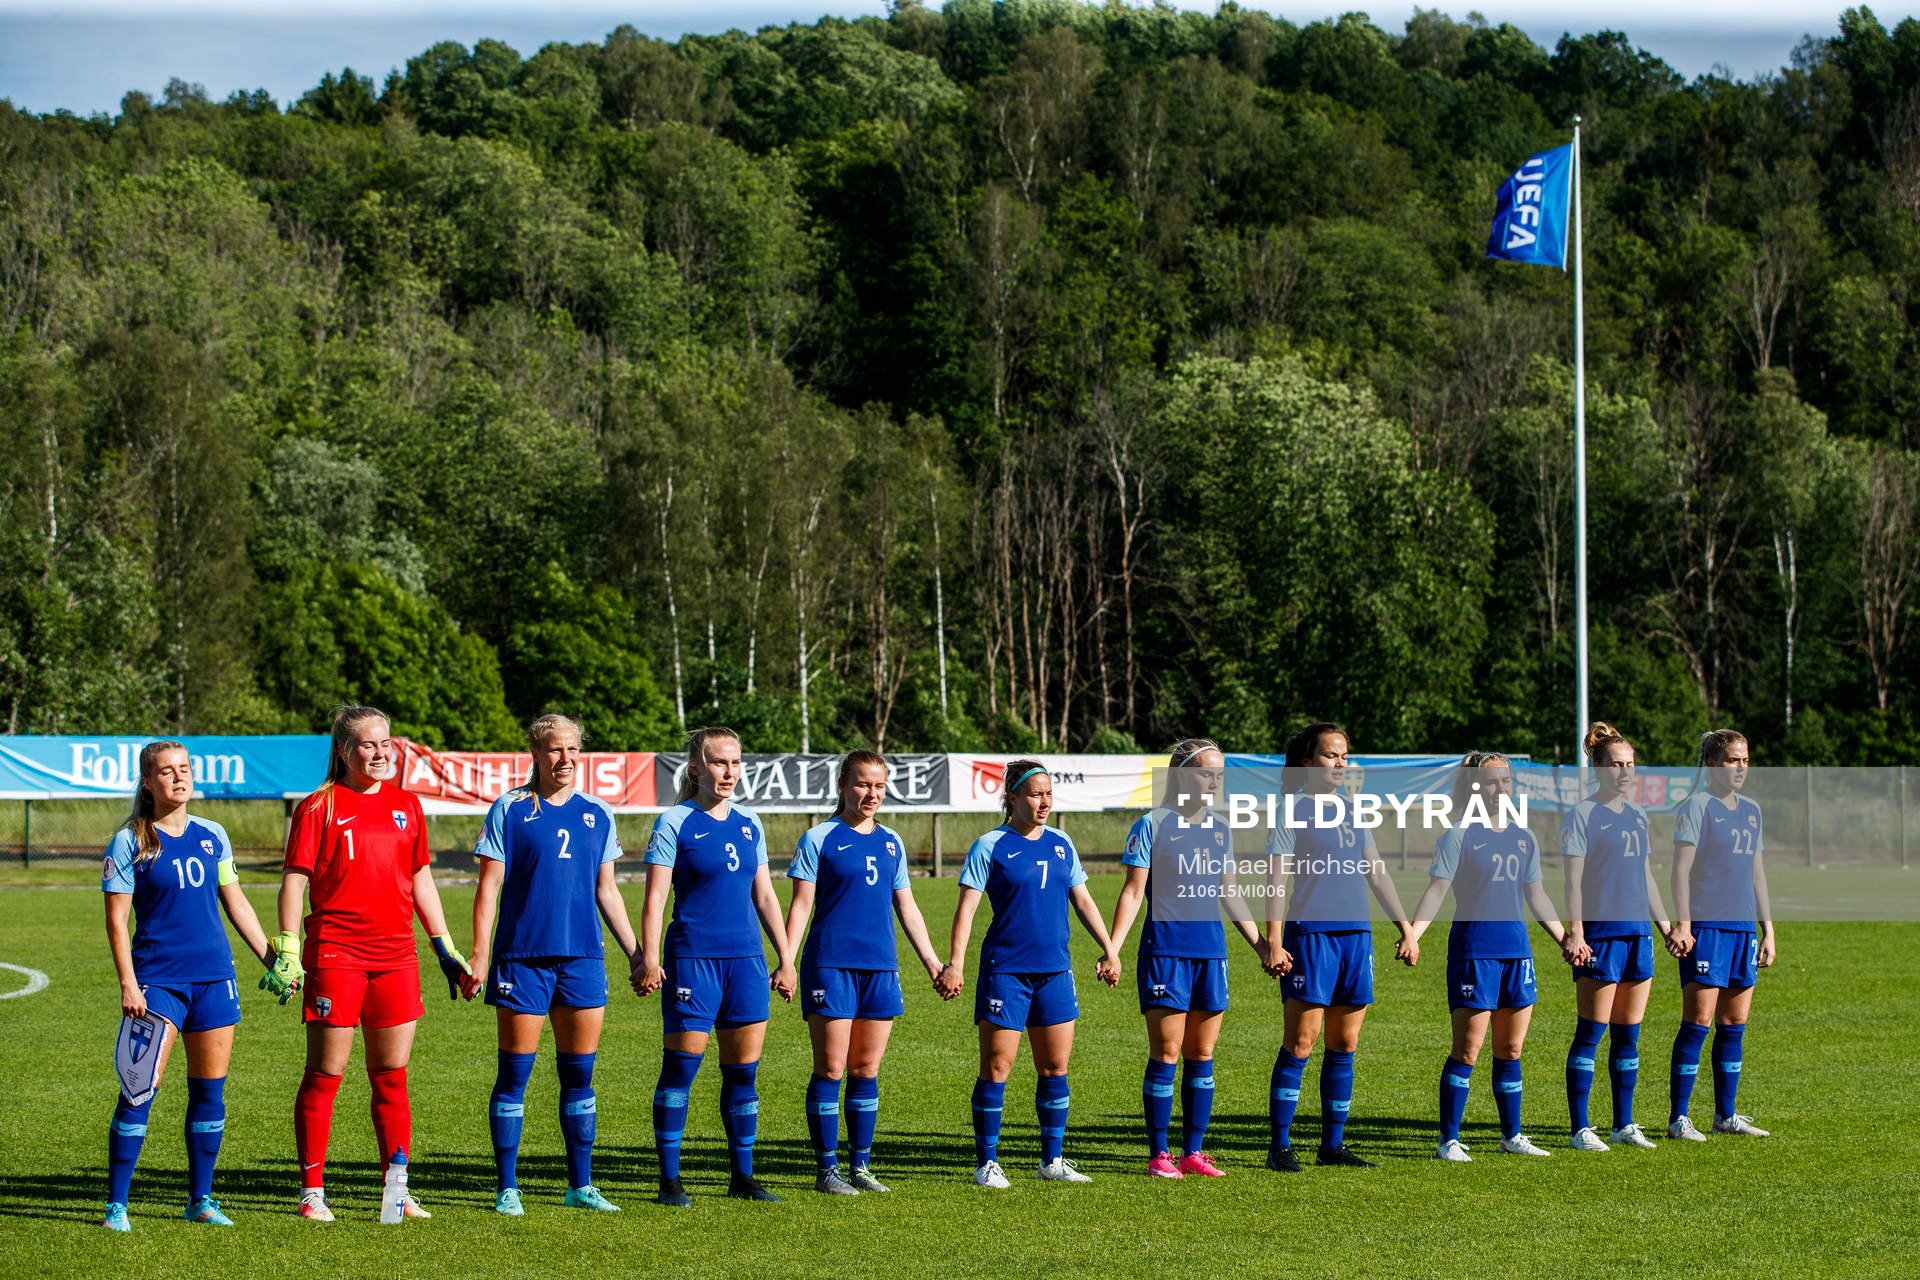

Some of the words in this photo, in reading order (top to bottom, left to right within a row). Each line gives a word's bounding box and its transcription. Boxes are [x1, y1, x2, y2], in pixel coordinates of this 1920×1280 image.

[1506, 158, 1544, 249] UEFA
[343, 828, 355, 860] 1
[557, 828, 572, 859] 2
[1621, 829, 1641, 857] 21
[1731, 828, 1754, 855] 22
[724, 842, 740, 872] 3
[865, 855, 879, 886] 5
[1491, 853, 1520, 882] 20
[172, 856, 205, 889] 10
[1036, 860, 1049, 889] 7
